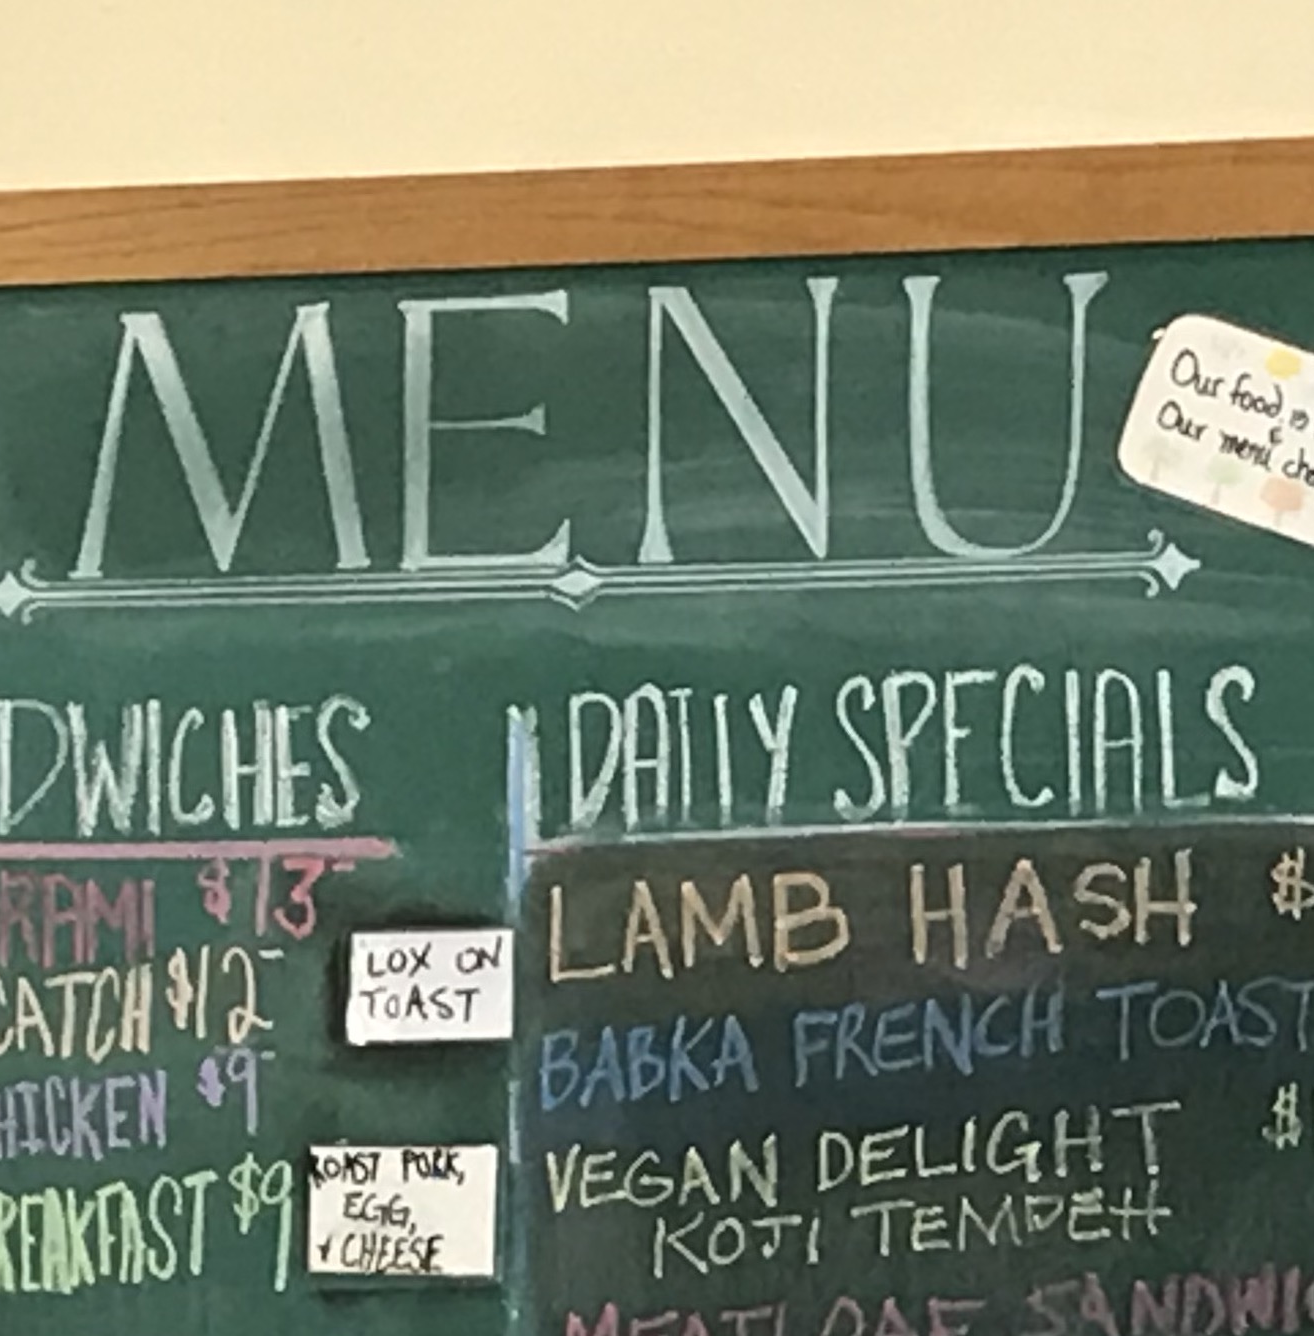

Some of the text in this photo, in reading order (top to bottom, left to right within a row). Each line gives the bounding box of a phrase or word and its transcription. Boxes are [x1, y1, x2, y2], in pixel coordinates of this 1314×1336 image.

[66, 270, 1110, 580] MENU
[1171, 348, 1224, 398] Our
[1229, 372, 1284, 419] food
[1156, 400, 1207, 442] Our
[1218, 430, 1273, 472] menu
[834, 664, 1259, 823] SPECIALS
[367, 935, 502, 978] LOX ON
[548, 868, 853, 984] LAMB
[908, 847, 1200, 970] HASH
[359, 985, 481, 1023] TOAST
[538, 1012, 760, 1114] BABKA
[794, 981, 1065, 1087] FRENCH
[310, 1152, 381, 1188] ROAST
[544, 1132, 778, 1213] VEGAN
[818, 1101, 1181, 1191] DELIGHT
[229, 1152, 291, 1291] $9
[341, 1232, 444, 1273] CHEESE
[651, 1179, 1172, 1279] KOJI TEMPEH
